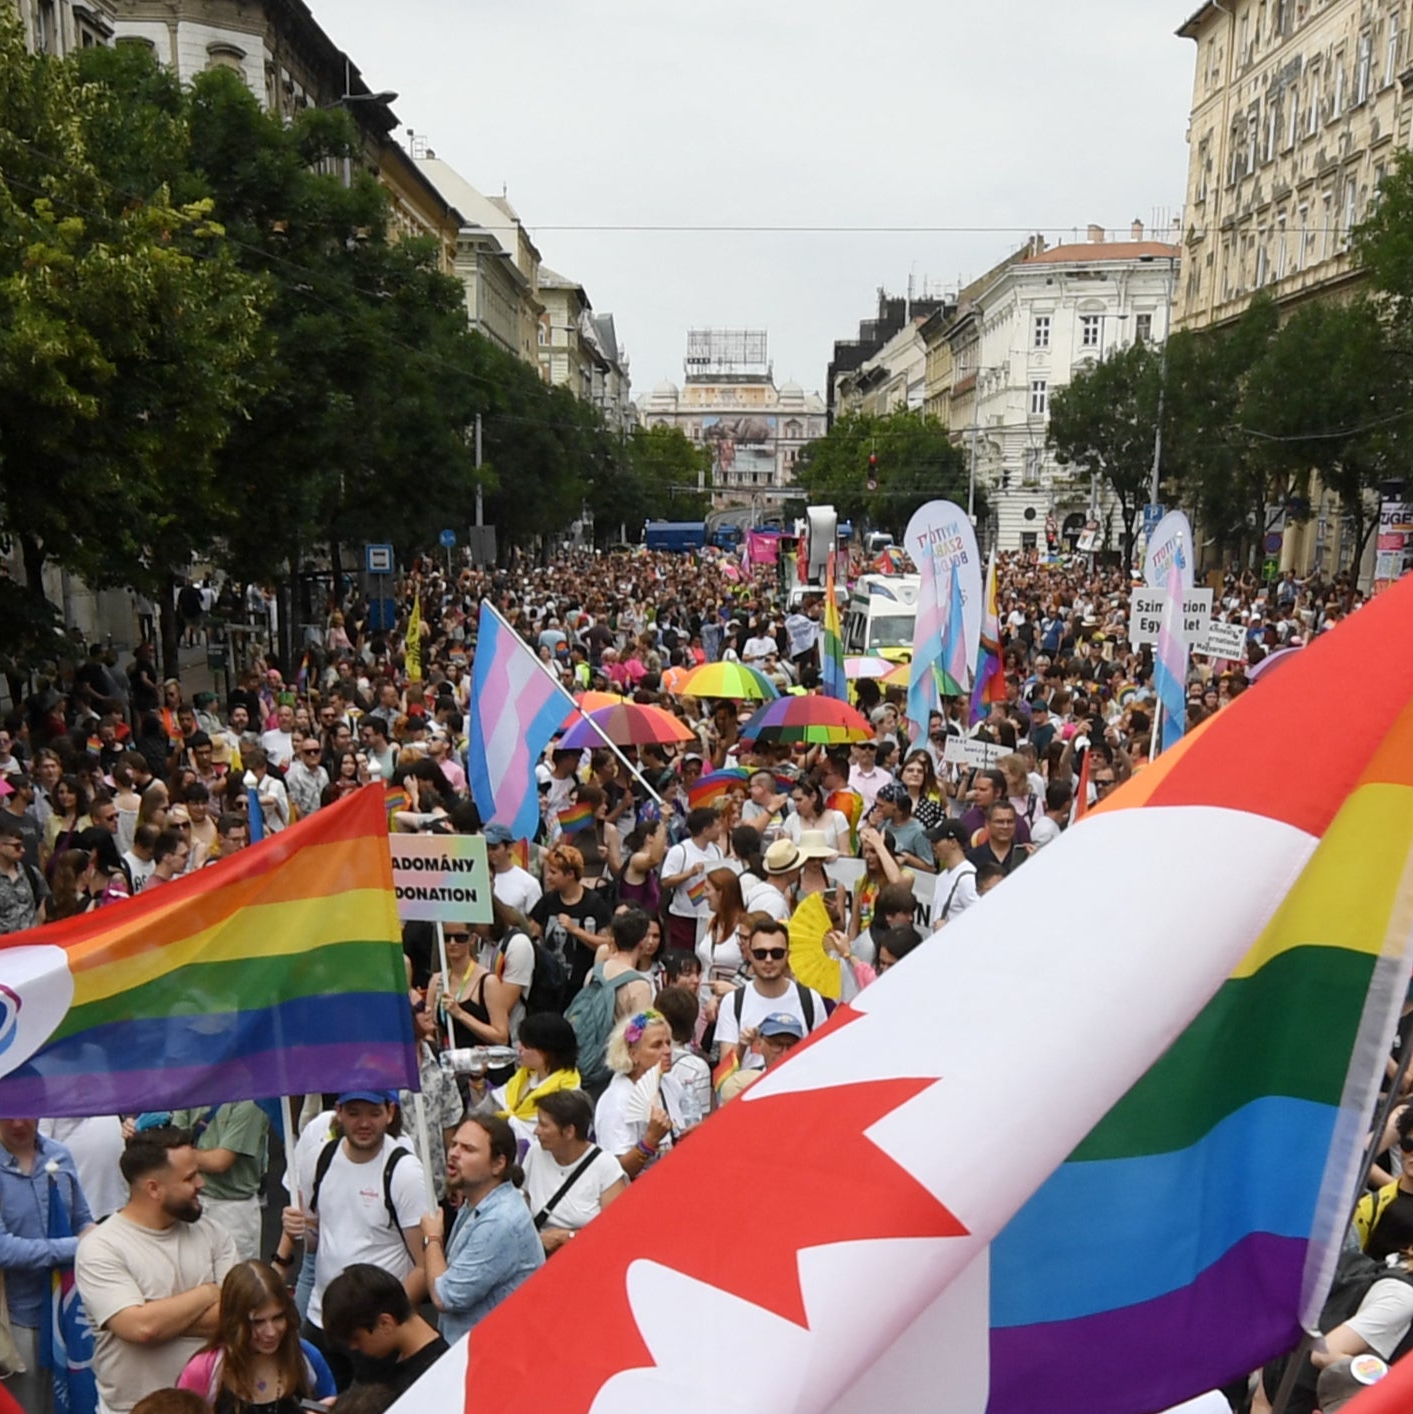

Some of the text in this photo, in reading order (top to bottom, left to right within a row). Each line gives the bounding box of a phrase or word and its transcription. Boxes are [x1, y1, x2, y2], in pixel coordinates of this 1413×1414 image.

[1136, 600, 1206, 613] Szimzion
[1140, 618, 1200, 633] Egylet
[392, 853, 474, 872] ADOMÁNY
[395, 887, 477, 902] DONATION
